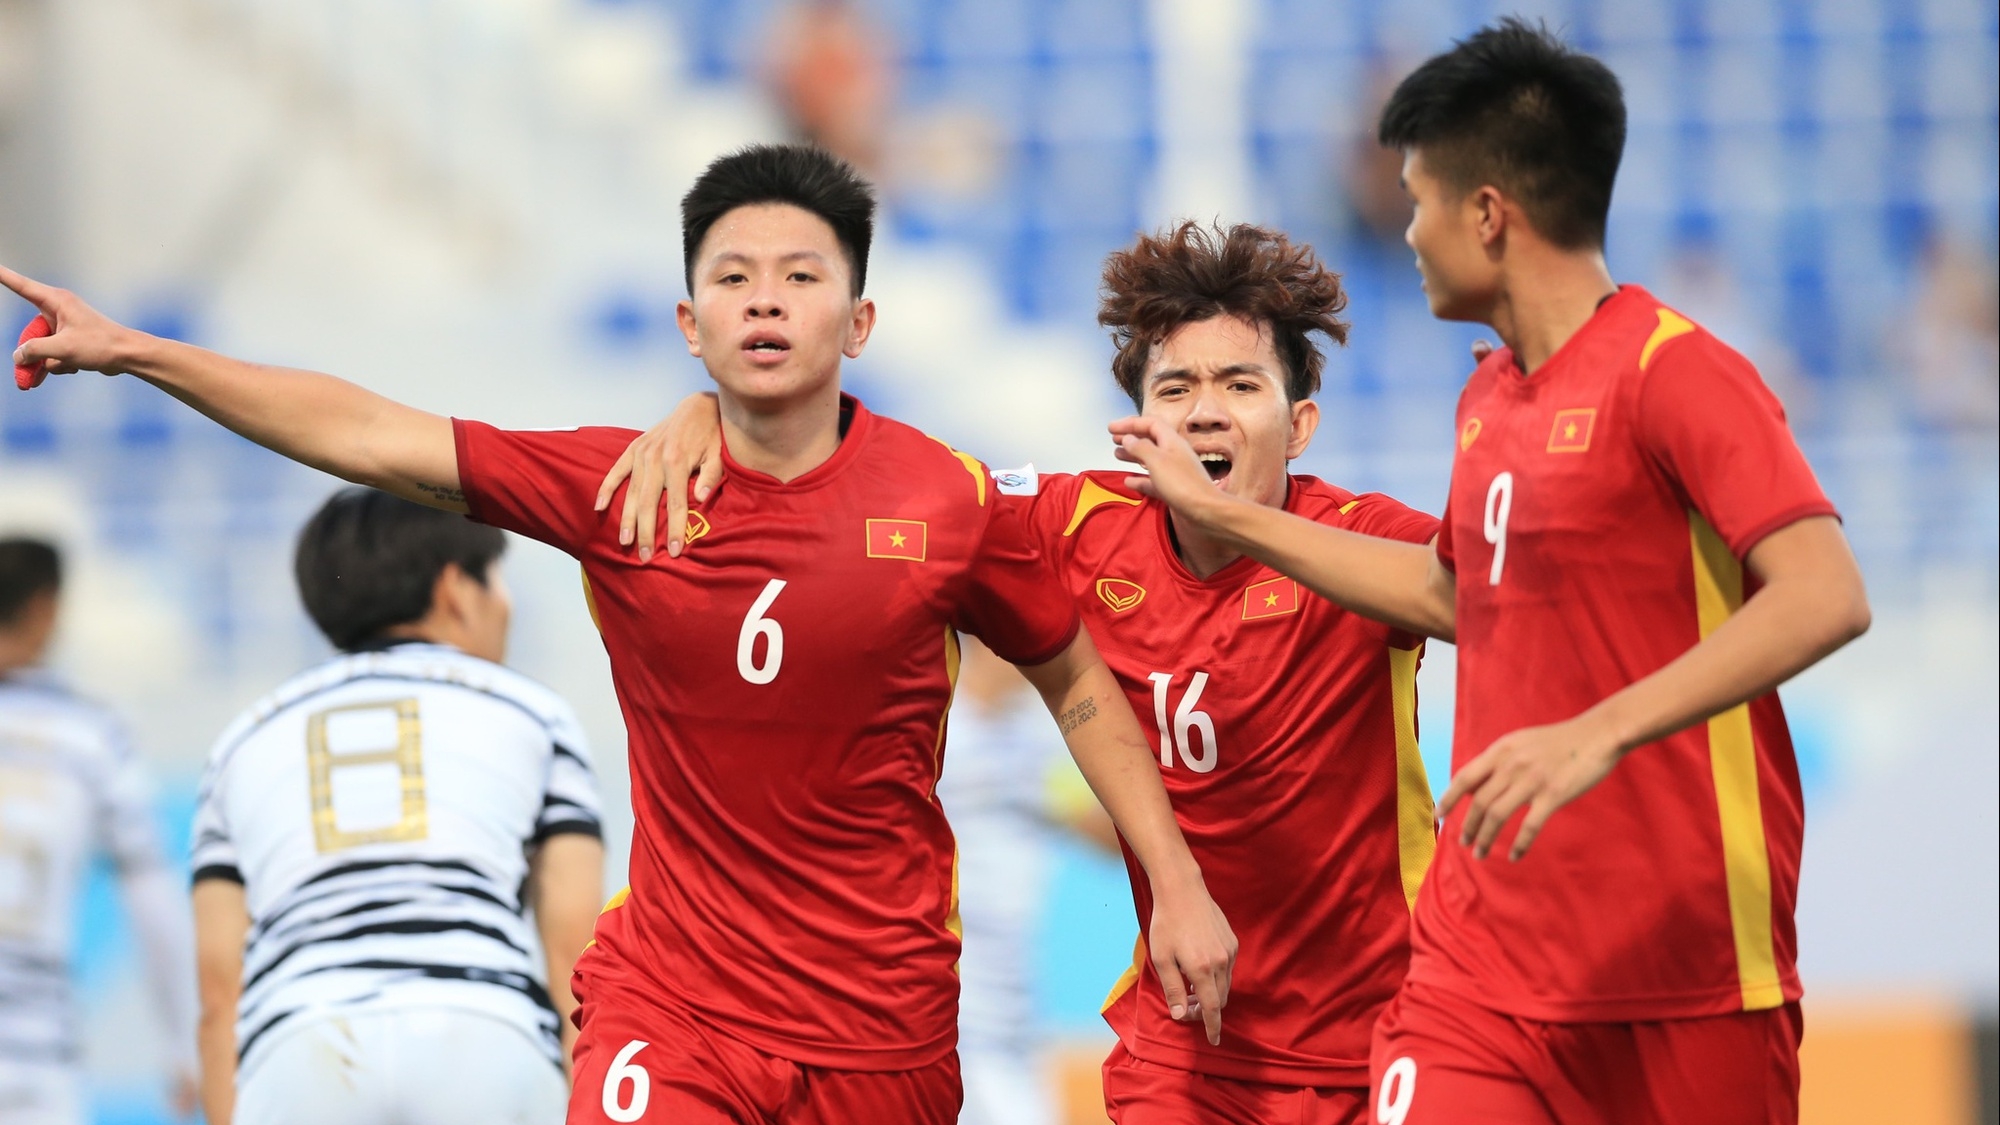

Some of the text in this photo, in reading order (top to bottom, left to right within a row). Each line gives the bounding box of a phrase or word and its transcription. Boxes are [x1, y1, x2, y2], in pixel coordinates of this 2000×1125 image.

[1483, 470, 1513, 586] 9
[736, 578, 787, 685] 6
[1076, 696, 1094, 714] 2002
[1078, 706, 1097, 725] 2022
[1147, 671, 1217, 774] 16
[306, 697, 428, 855] 8
[601, 1039, 651, 1123] 6
[1376, 1056, 1417, 1125] 9
